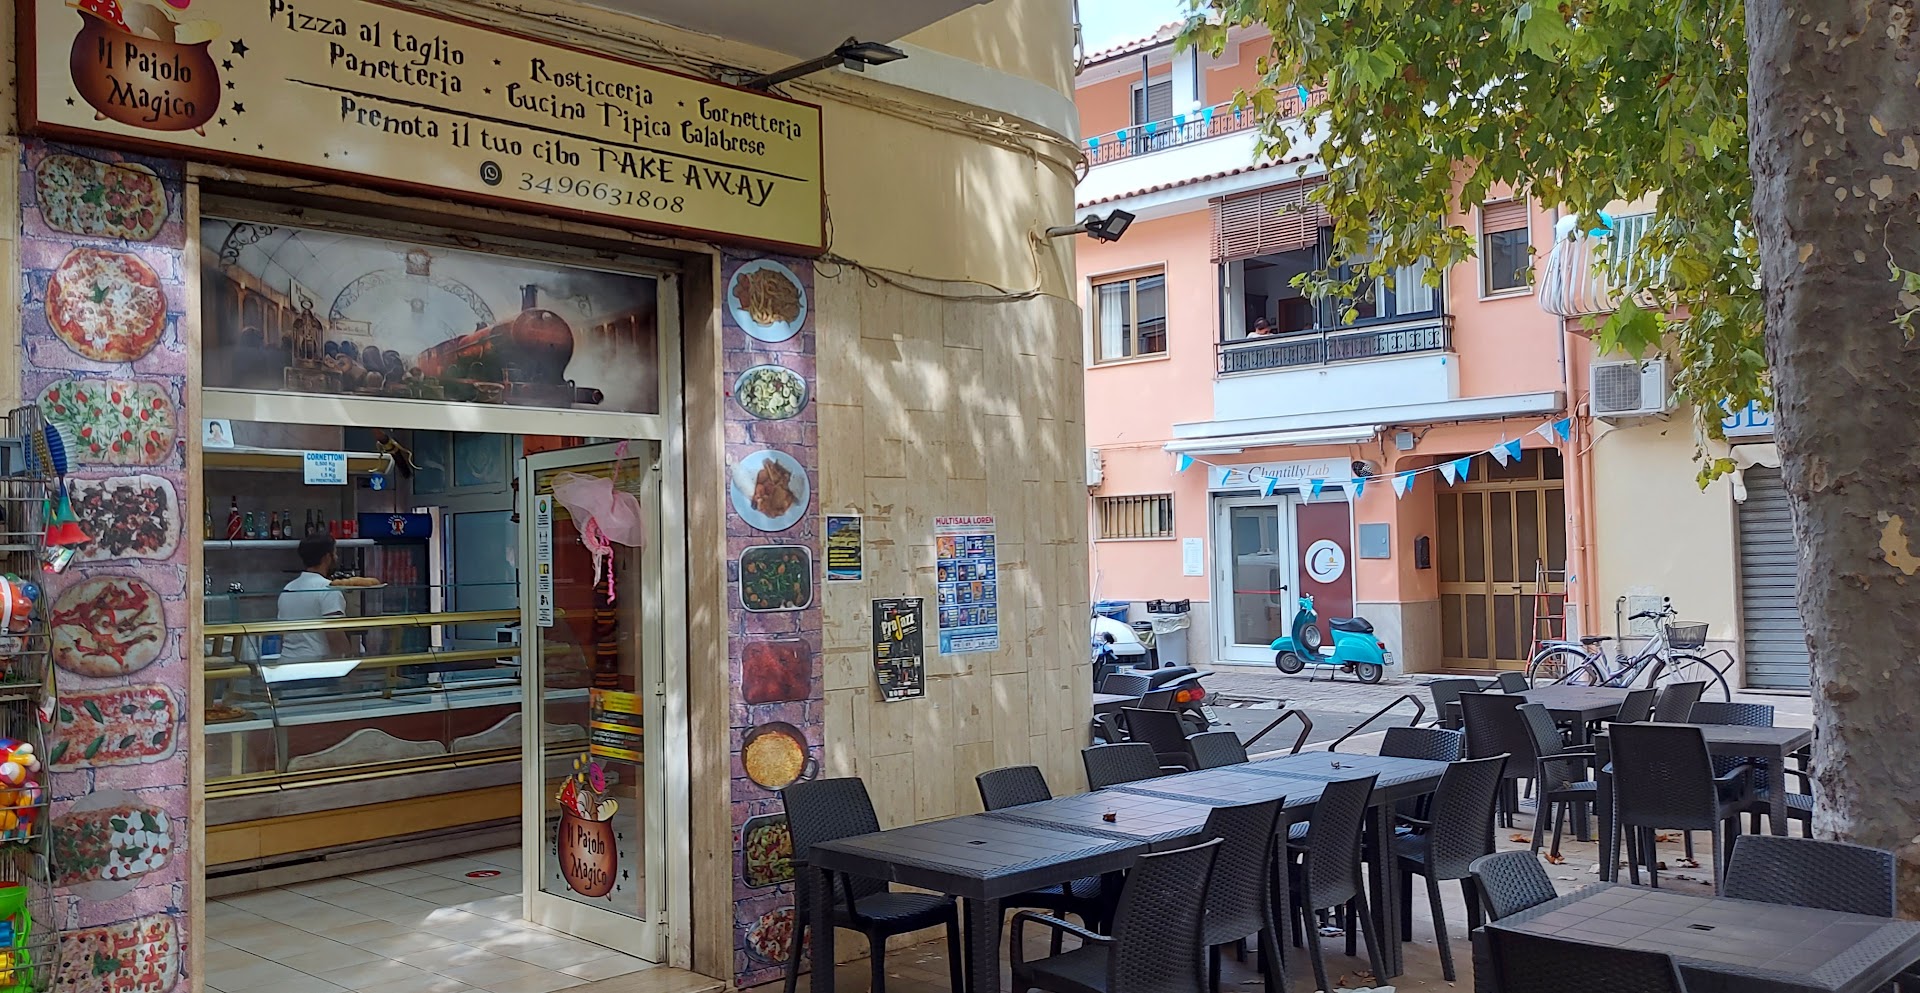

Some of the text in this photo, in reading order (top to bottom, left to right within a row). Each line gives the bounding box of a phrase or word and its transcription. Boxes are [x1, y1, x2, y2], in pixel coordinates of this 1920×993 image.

[269, 0, 465, 66] Pizza al taglio
[98, 36, 191, 83] Il Paiolo
[329, 41, 462, 96] Panetteria
[529, 57, 653, 108] Rosticceria
[105, 74, 195, 122] Magico
[505, 82, 765, 156] Cucina Tipica Calabrese
[698, 96, 801, 140] Cornetteria
[340, 95, 775, 207] Prenota il tuo cibo TAKE AWAY
[518, 172, 685, 213] 3496631808
[307, 453, 345, 461] CORNETTONI
[936, 516, 994, 525] MULTISALA LOREN
[567, 823, 574, 847] Il
[577, 825, 605, 855] Paiolo
[570, 852, 606, 890] Magico
